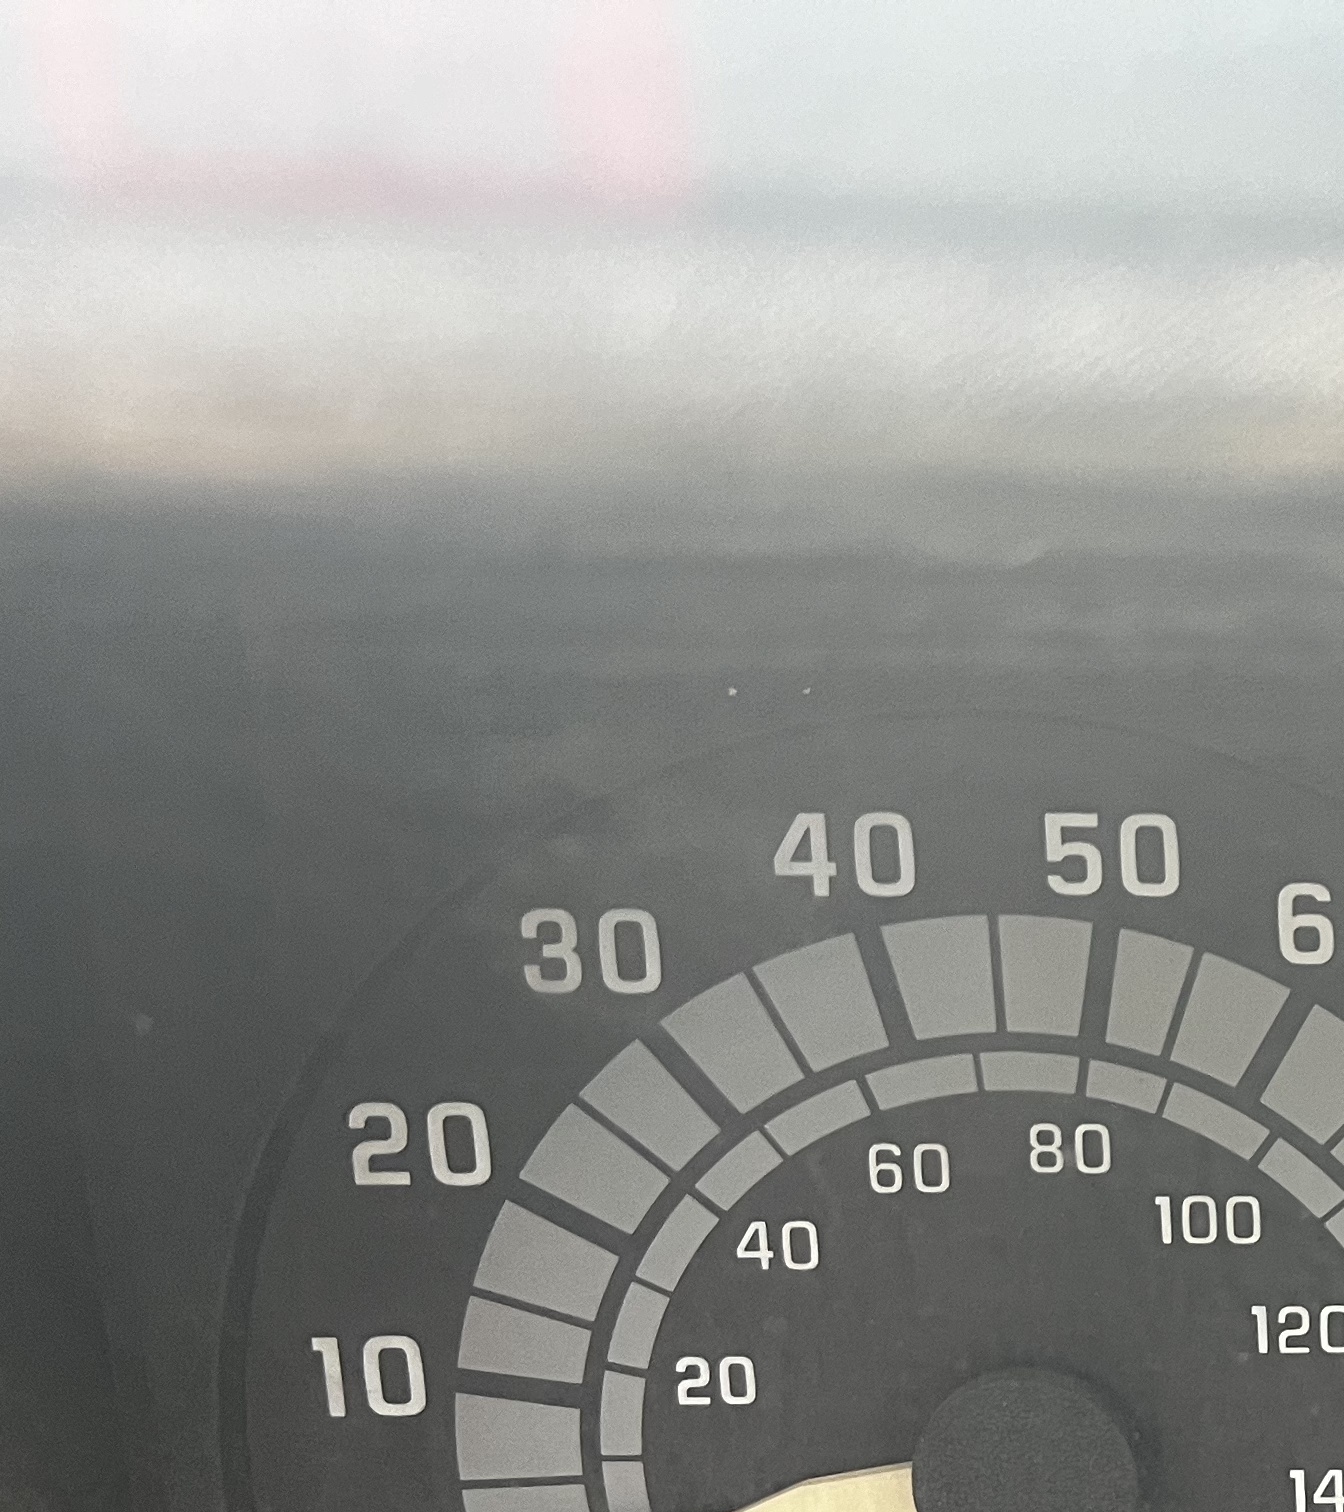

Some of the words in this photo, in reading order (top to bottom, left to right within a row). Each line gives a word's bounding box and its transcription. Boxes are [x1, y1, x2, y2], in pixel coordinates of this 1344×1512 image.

[773, 811, 916, 898] 40
[1043, 812, 1181, 897] 50
[519, 907, 663, 994] 30
[347, 1101, 493, 1186] 20
[868, 1143, 950, 1193] 60
[1029, 1123, 1112, 1174] 80
[736, 1221, 820, 1271] 40
[1154, 1195, 1262, 1245] 100
[311, 1335, 427, 1418] 10
[675, 1356, 757, 1406] 20
